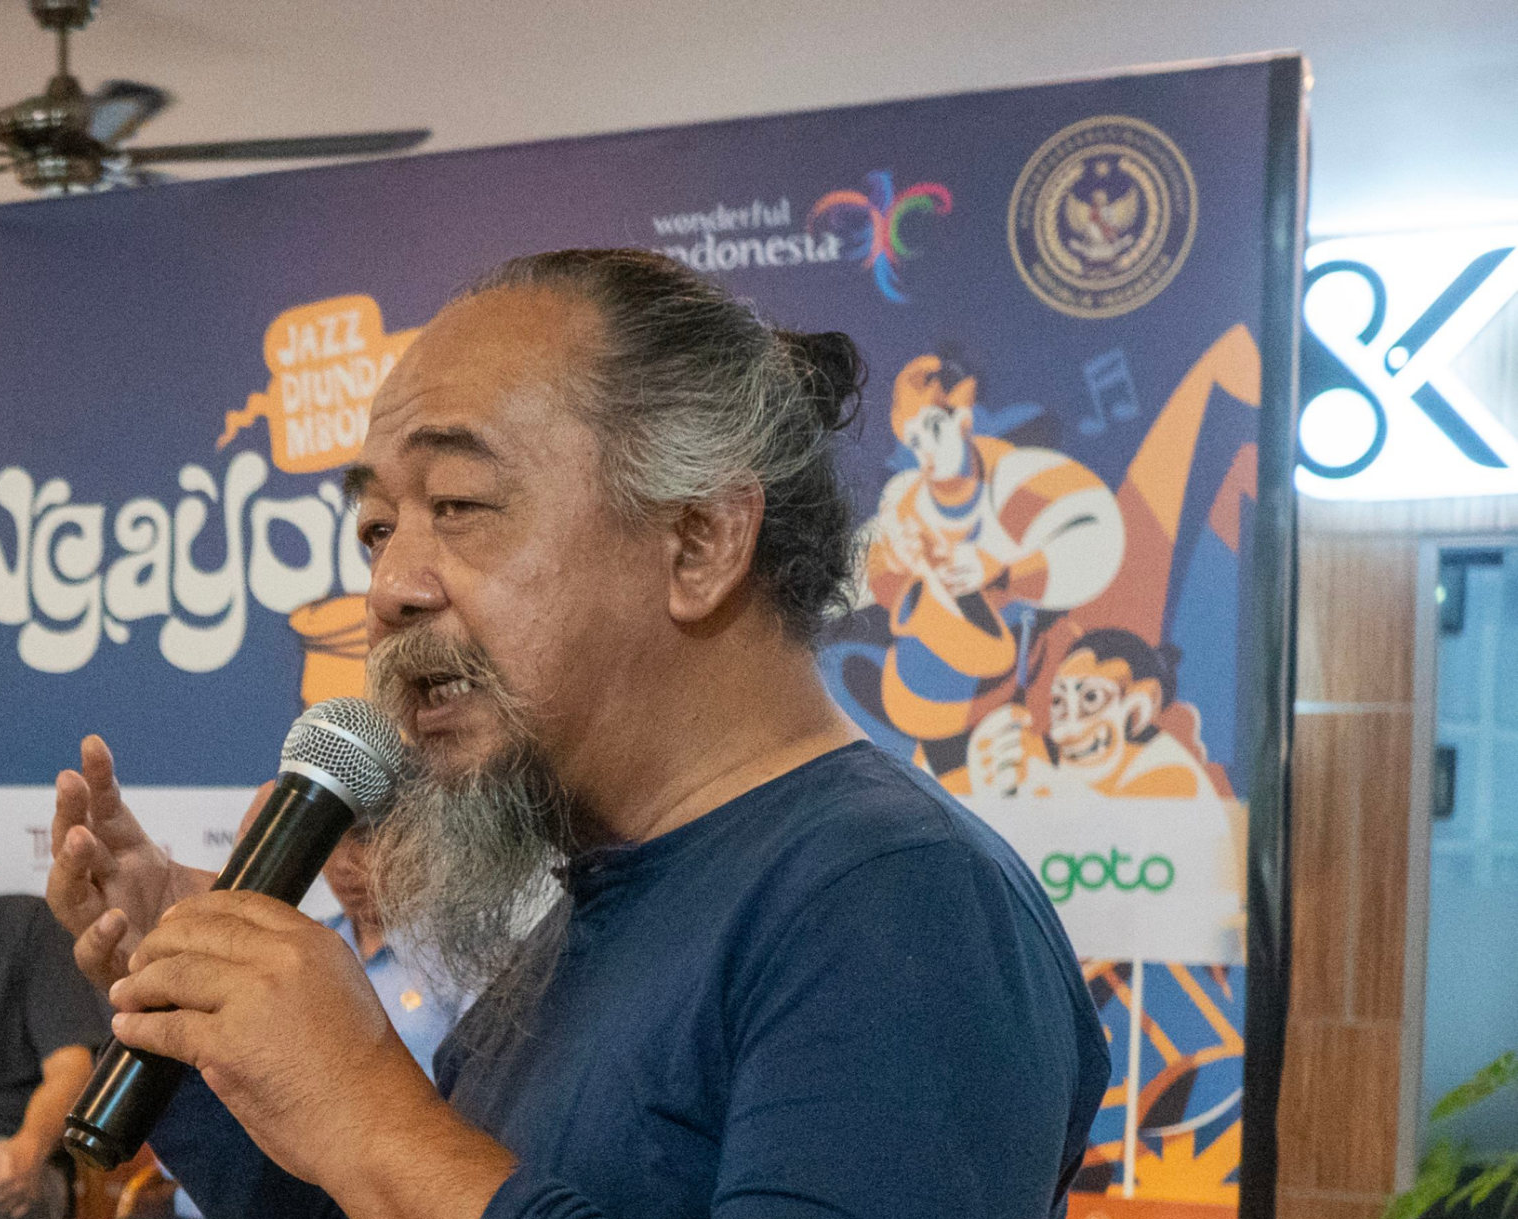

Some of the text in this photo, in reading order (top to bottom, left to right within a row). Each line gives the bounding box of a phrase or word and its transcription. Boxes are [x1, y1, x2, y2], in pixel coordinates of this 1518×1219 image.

[653, 198, 791, 234] wonderful
[650, 231, 844, 273] ndonesia
[278, 311, 366, 366] JAZZ
[1040, 846, 1176, 904] goto
